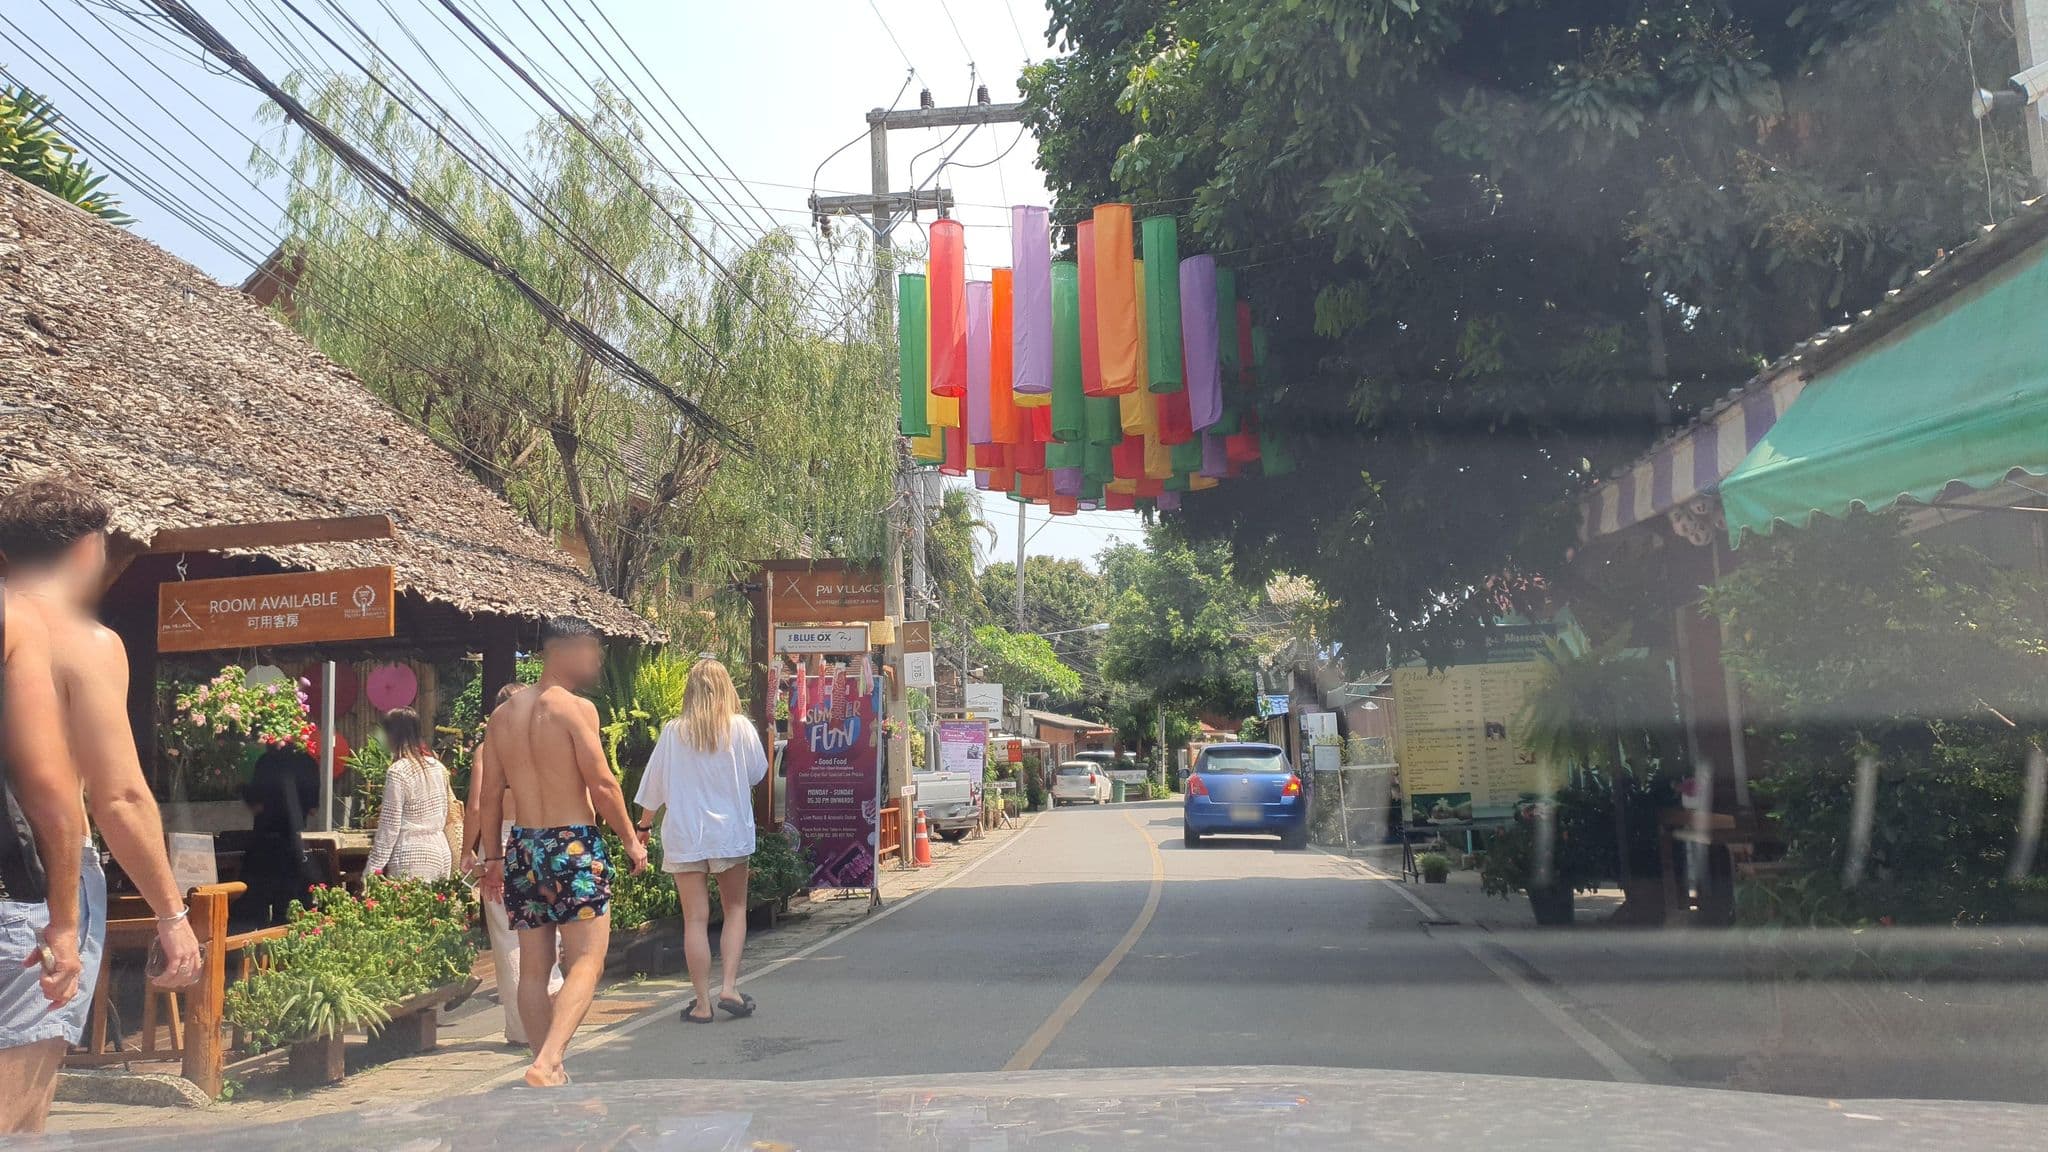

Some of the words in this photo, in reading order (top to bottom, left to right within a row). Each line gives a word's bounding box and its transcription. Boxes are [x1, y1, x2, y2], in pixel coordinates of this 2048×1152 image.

[816, 585, 833, 597] PAI
[209, 598, 256, 614] ROOM
[260, 591, 338, 610] AVAILABLE
[248, 613, 300, 630] 可用客房
[793, 633, 816, 642] BLUE
[817, 633, 832, 641] OX
[811, 719, 855, 752] FUN
